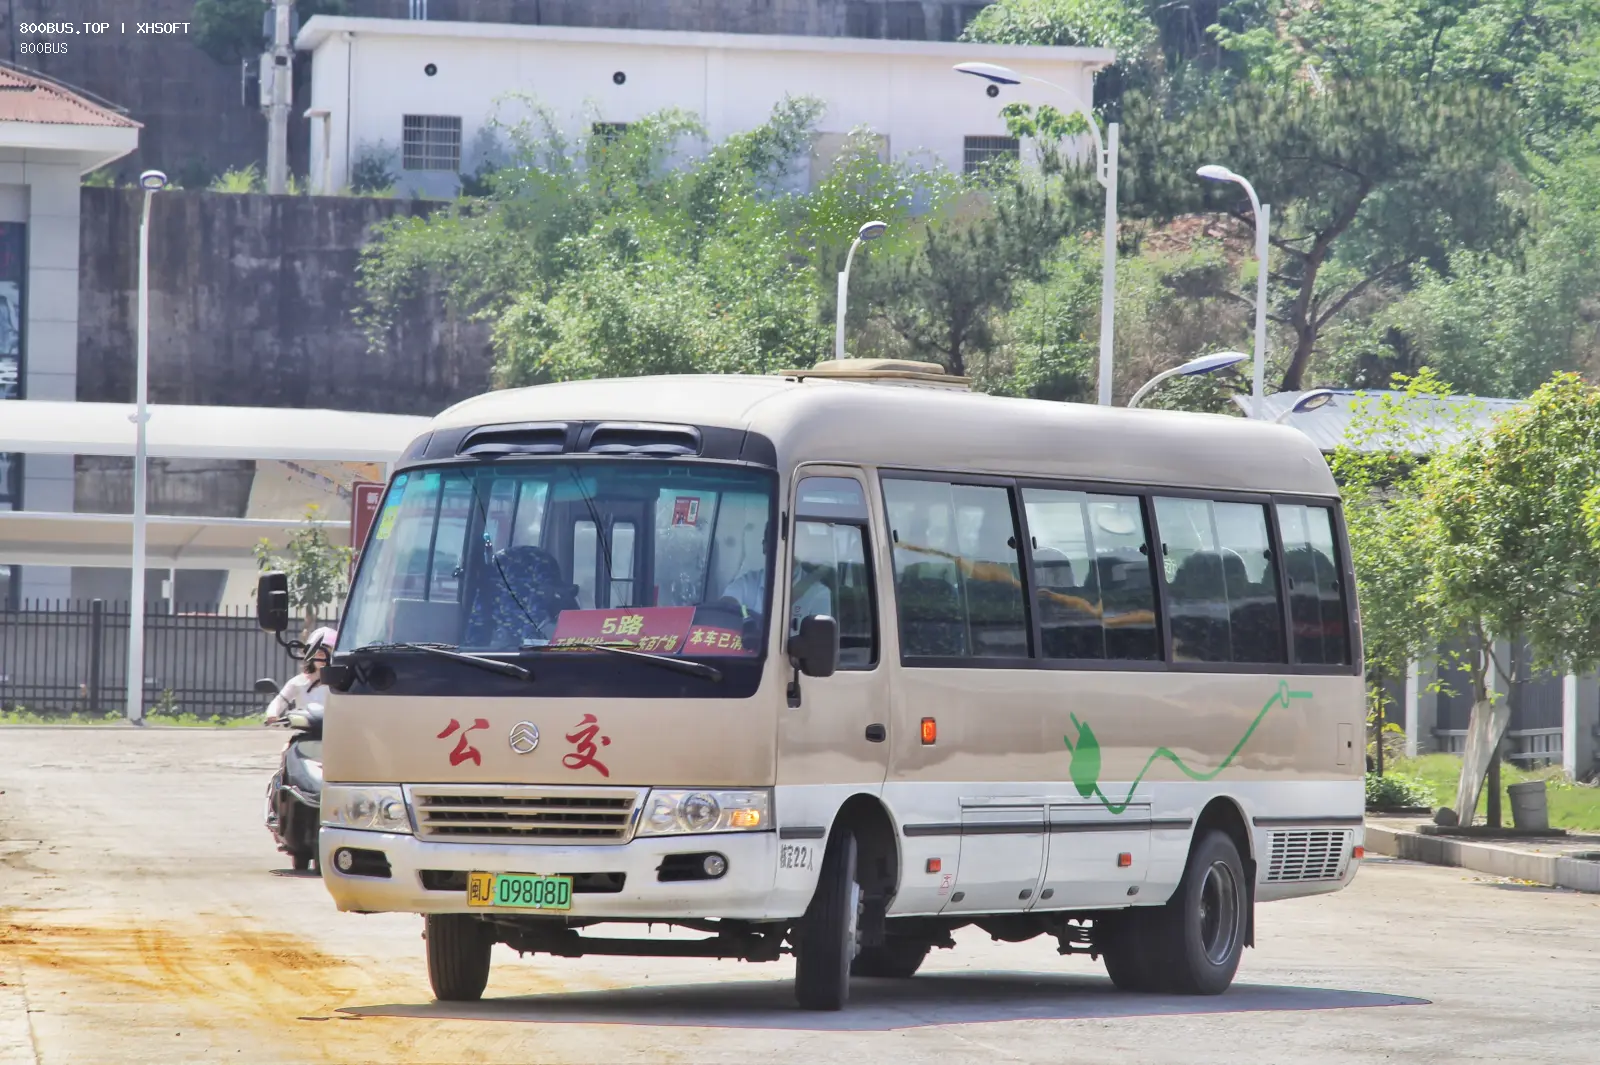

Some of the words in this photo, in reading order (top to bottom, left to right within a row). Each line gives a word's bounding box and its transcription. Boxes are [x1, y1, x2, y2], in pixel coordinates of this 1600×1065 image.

[602, 615, 644, 636] 5路
[690, 628, 742, 651] 本车已消
